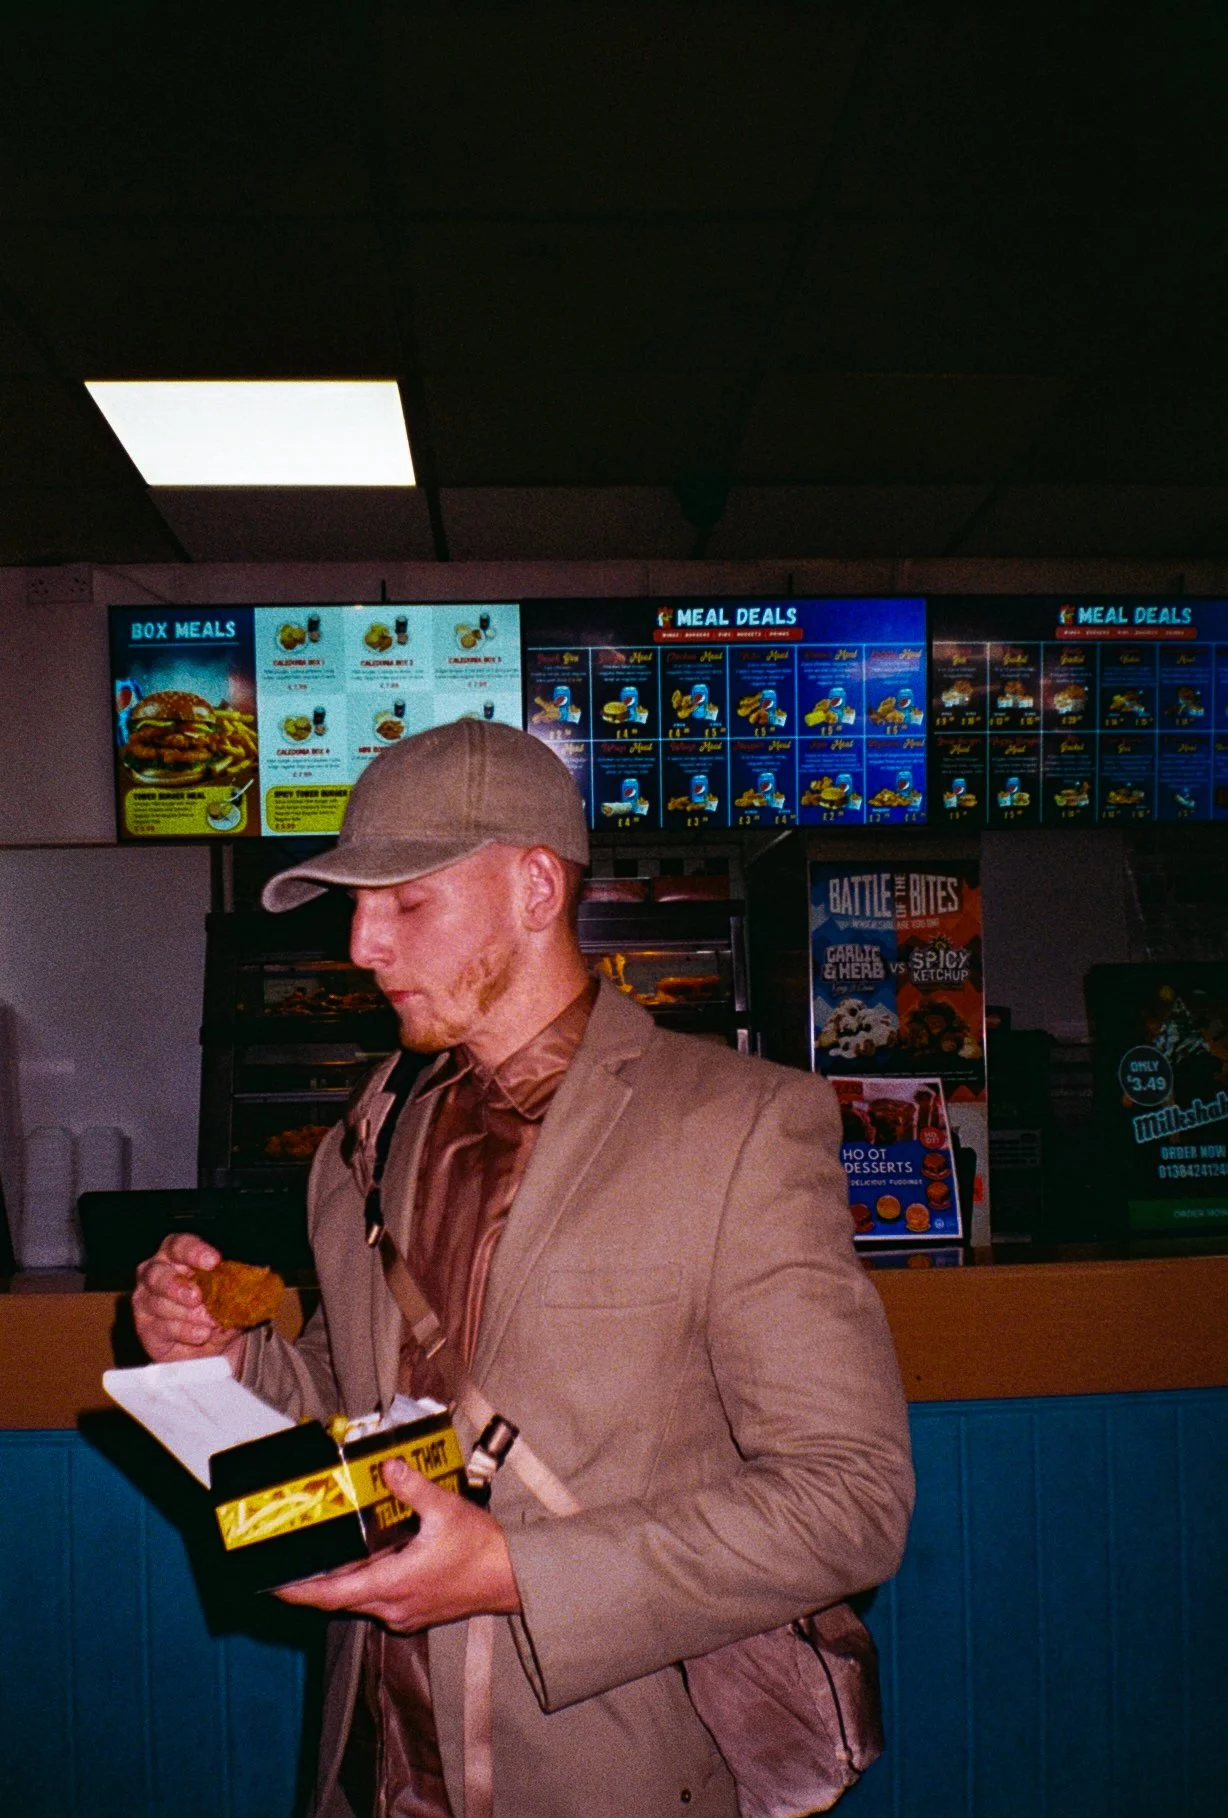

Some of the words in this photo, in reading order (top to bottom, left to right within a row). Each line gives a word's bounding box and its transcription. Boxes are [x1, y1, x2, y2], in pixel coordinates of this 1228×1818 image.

[676, 607, 730, 627] MEAL
[736, 606, 798, 626] DEALS
[1078, 606, 1129, 625] MEAL
[1134, 606, 1193, 625] DEALS
[131, 621, 168, 640] BOX
[175, 620, 236, 639] MEALS
[629, 651, 653, 664] Meal
[699, 651, 724, 662] Meal
[766, 649, 789, 661] Meal
[834, 649, 858, 661] Meal
[628, 742, 653, 754] Meal
[699, 741, 723, 752] Meal
[768, 740, 791, 752] Meal
[830, 739, 854, 751] Meal
[903, 738, 925, 750] Meal
[894, 873, 907, 896] THE
[828, 872, 893, 918] BATTLE
[909, 872, 959, 917] BITES
[895, 904, 908, 919] OF
[826, 944, 882, 963] GARLIC
[912, 949, 969, 970] SPICY
[824, 962, 836, 980] &
[838, 961, 885, 980] HERB
[889, 963, 906, 974] VS
[912, 969, 970, 983] KETCHUP
[1130, 1060, 1160, 1073] ONLY
[842, 1148, 865, 1161] HO
[867, 1148, 888, 1160] OT
[1160, 1145, 1198, 1161] ORDER
[1199, 1144, 1227, 1159] NOW
[844, 1161, 913, 1174] DESSERTS
[411, 1438, 448, 1473] THAT
